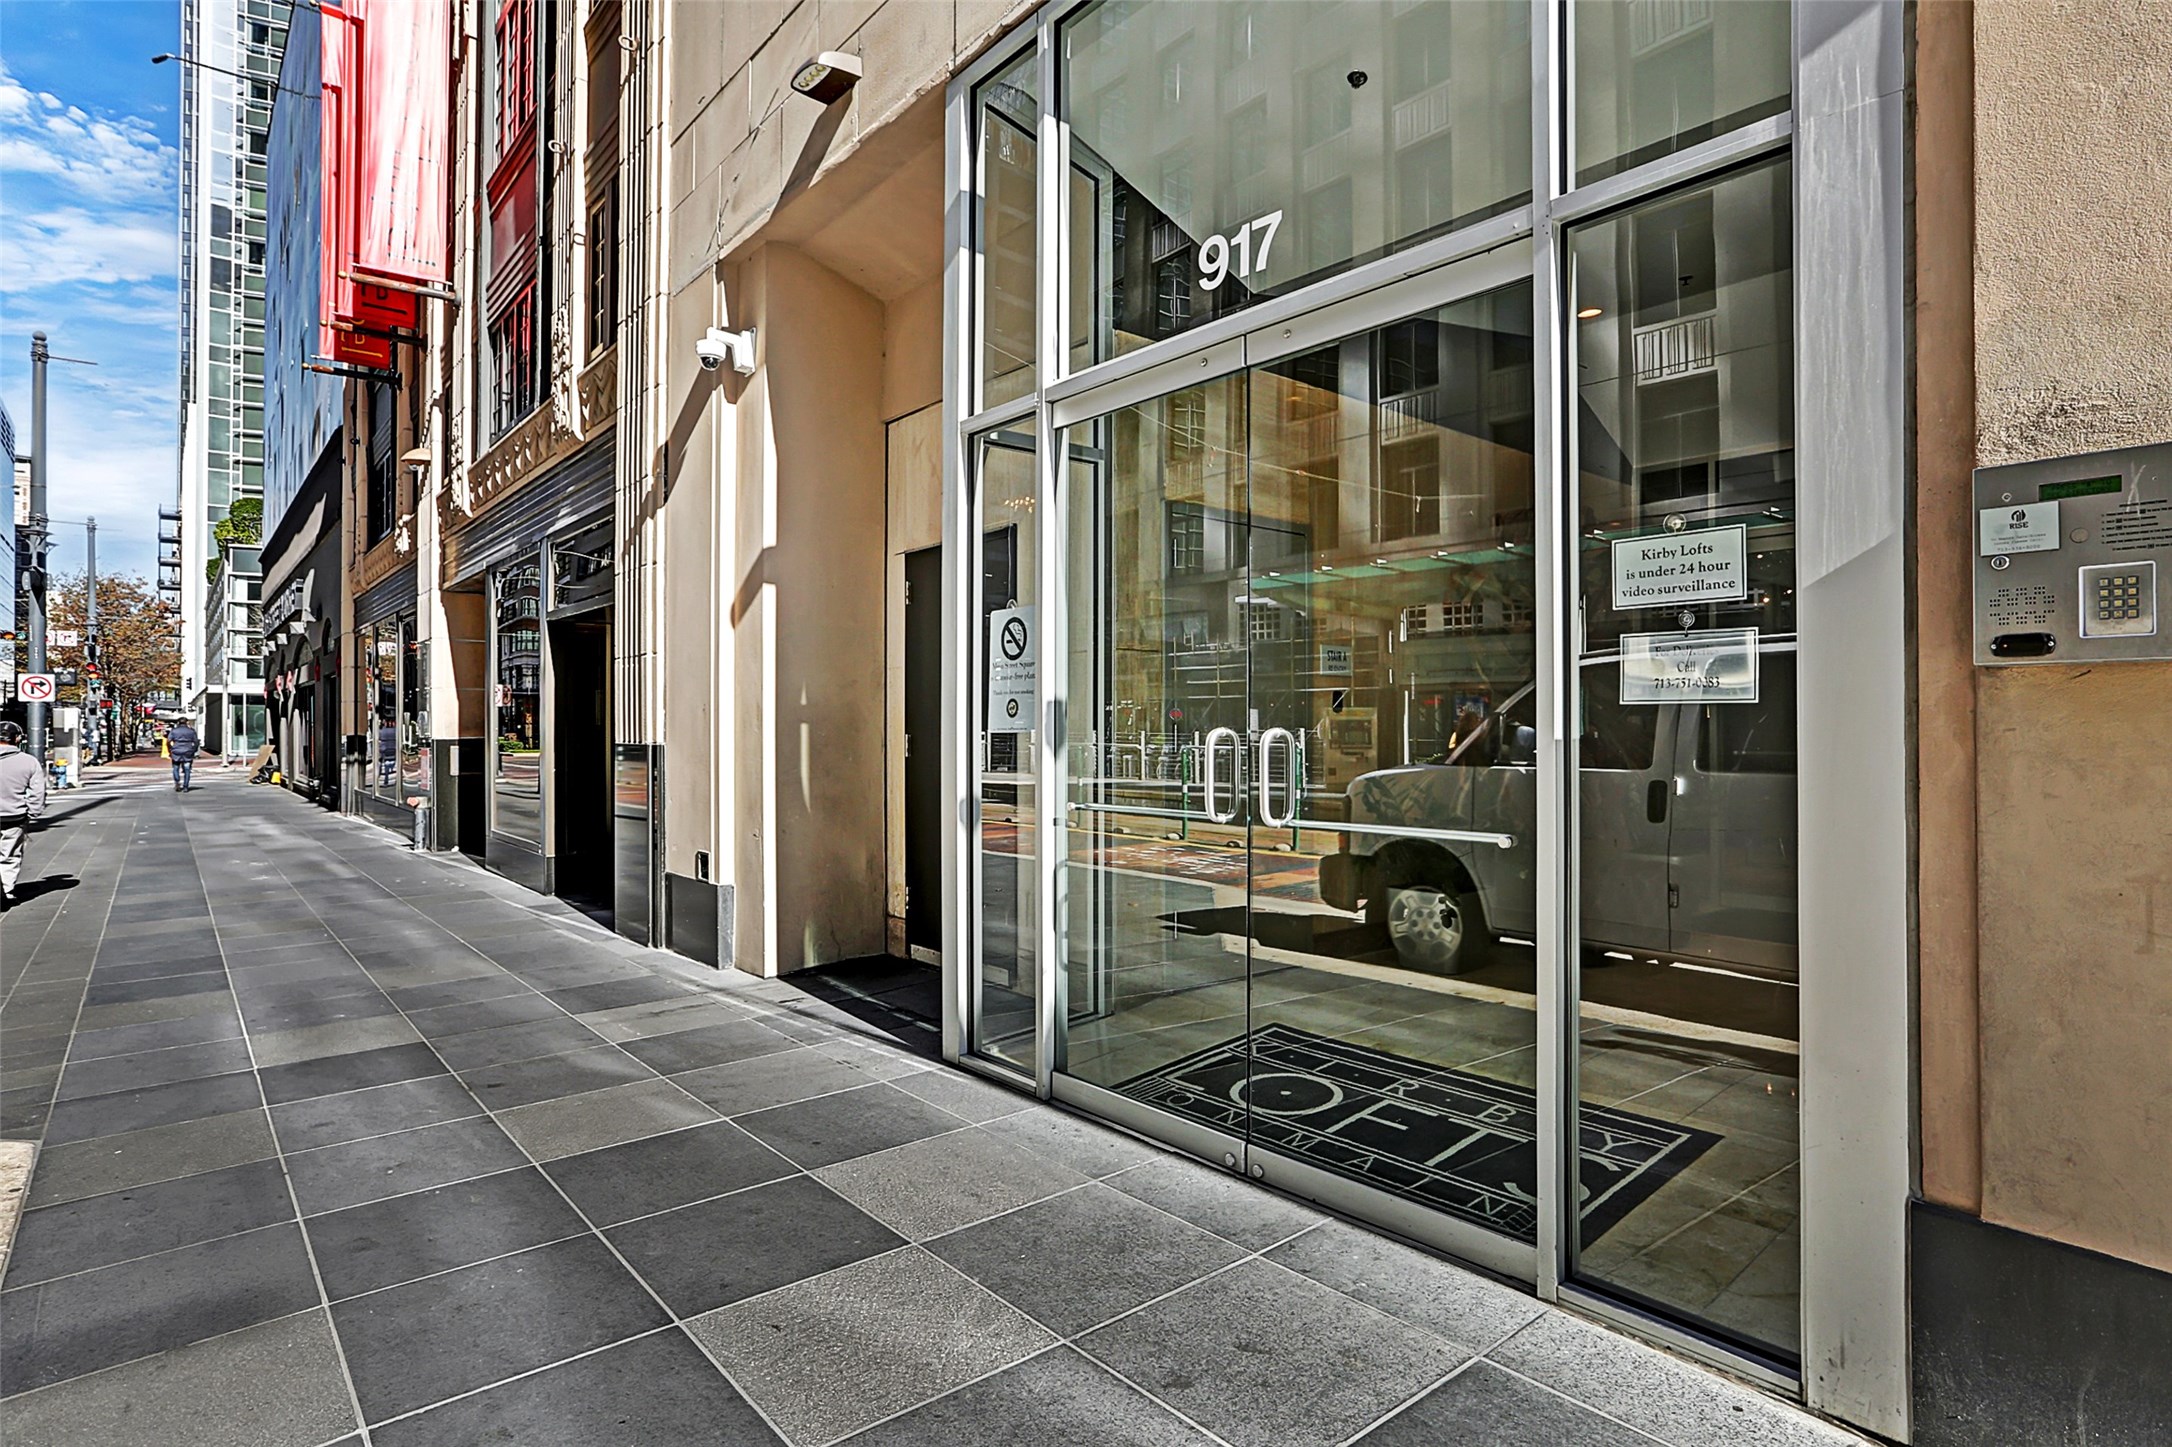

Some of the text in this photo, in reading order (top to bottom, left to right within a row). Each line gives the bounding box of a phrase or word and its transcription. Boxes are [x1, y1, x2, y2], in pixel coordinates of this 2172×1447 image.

[1198, 210, 1282, 291] 917
[2009, 521, 2029, 530] RISE
[1641, 542, 1713, 561] Kirby Lofts
[1626, 560, 1731, 580] is under 24 hour
[1622, 579, 1736, 598] video surveillance
[1676, 661, 1696, 673] Call
[1237, 1039, 1640, 1153] KIRBY
